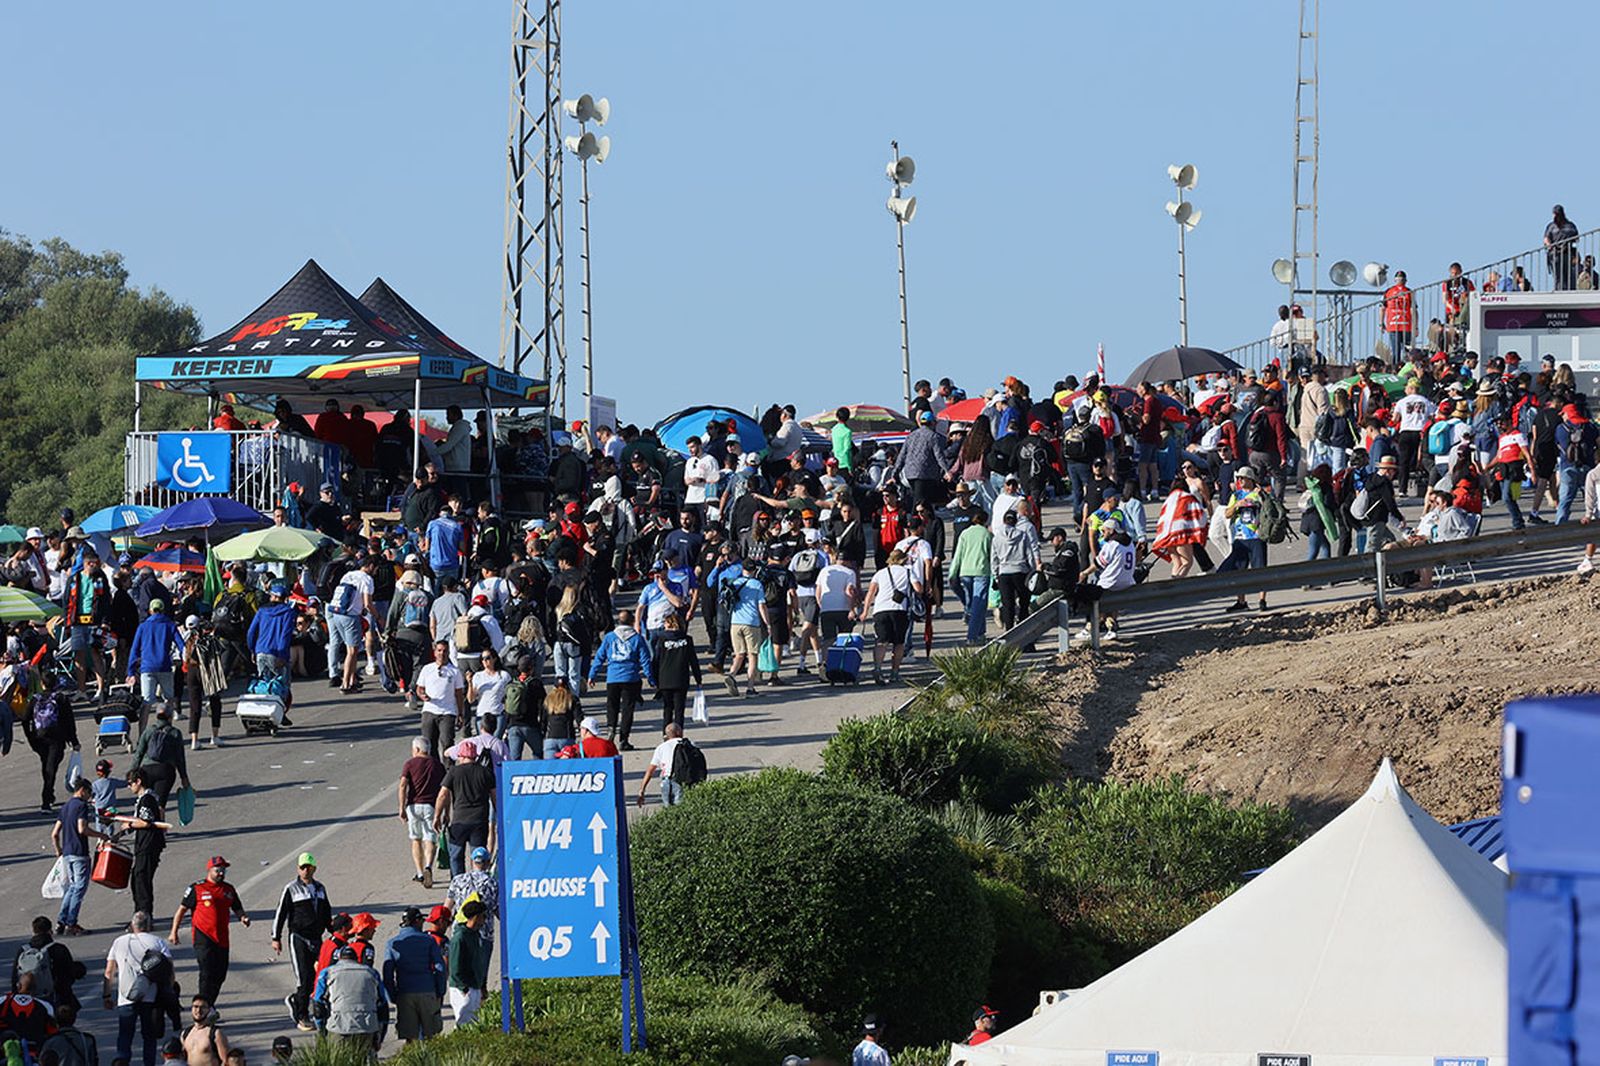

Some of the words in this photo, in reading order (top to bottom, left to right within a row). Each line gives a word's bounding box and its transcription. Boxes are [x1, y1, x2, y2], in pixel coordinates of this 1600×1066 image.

[188, 338, 386, 353] KARTING
[171, 360, 273, 376] KEFREN
[1124, 551, 1134, 570] 9
[510, 772, 607, 795] TRIBUNAS
[522, 818, 573, 851] W4
[511, 877, 587, 899] PELOUSSE
[528, 925, 573, 961] Q5
